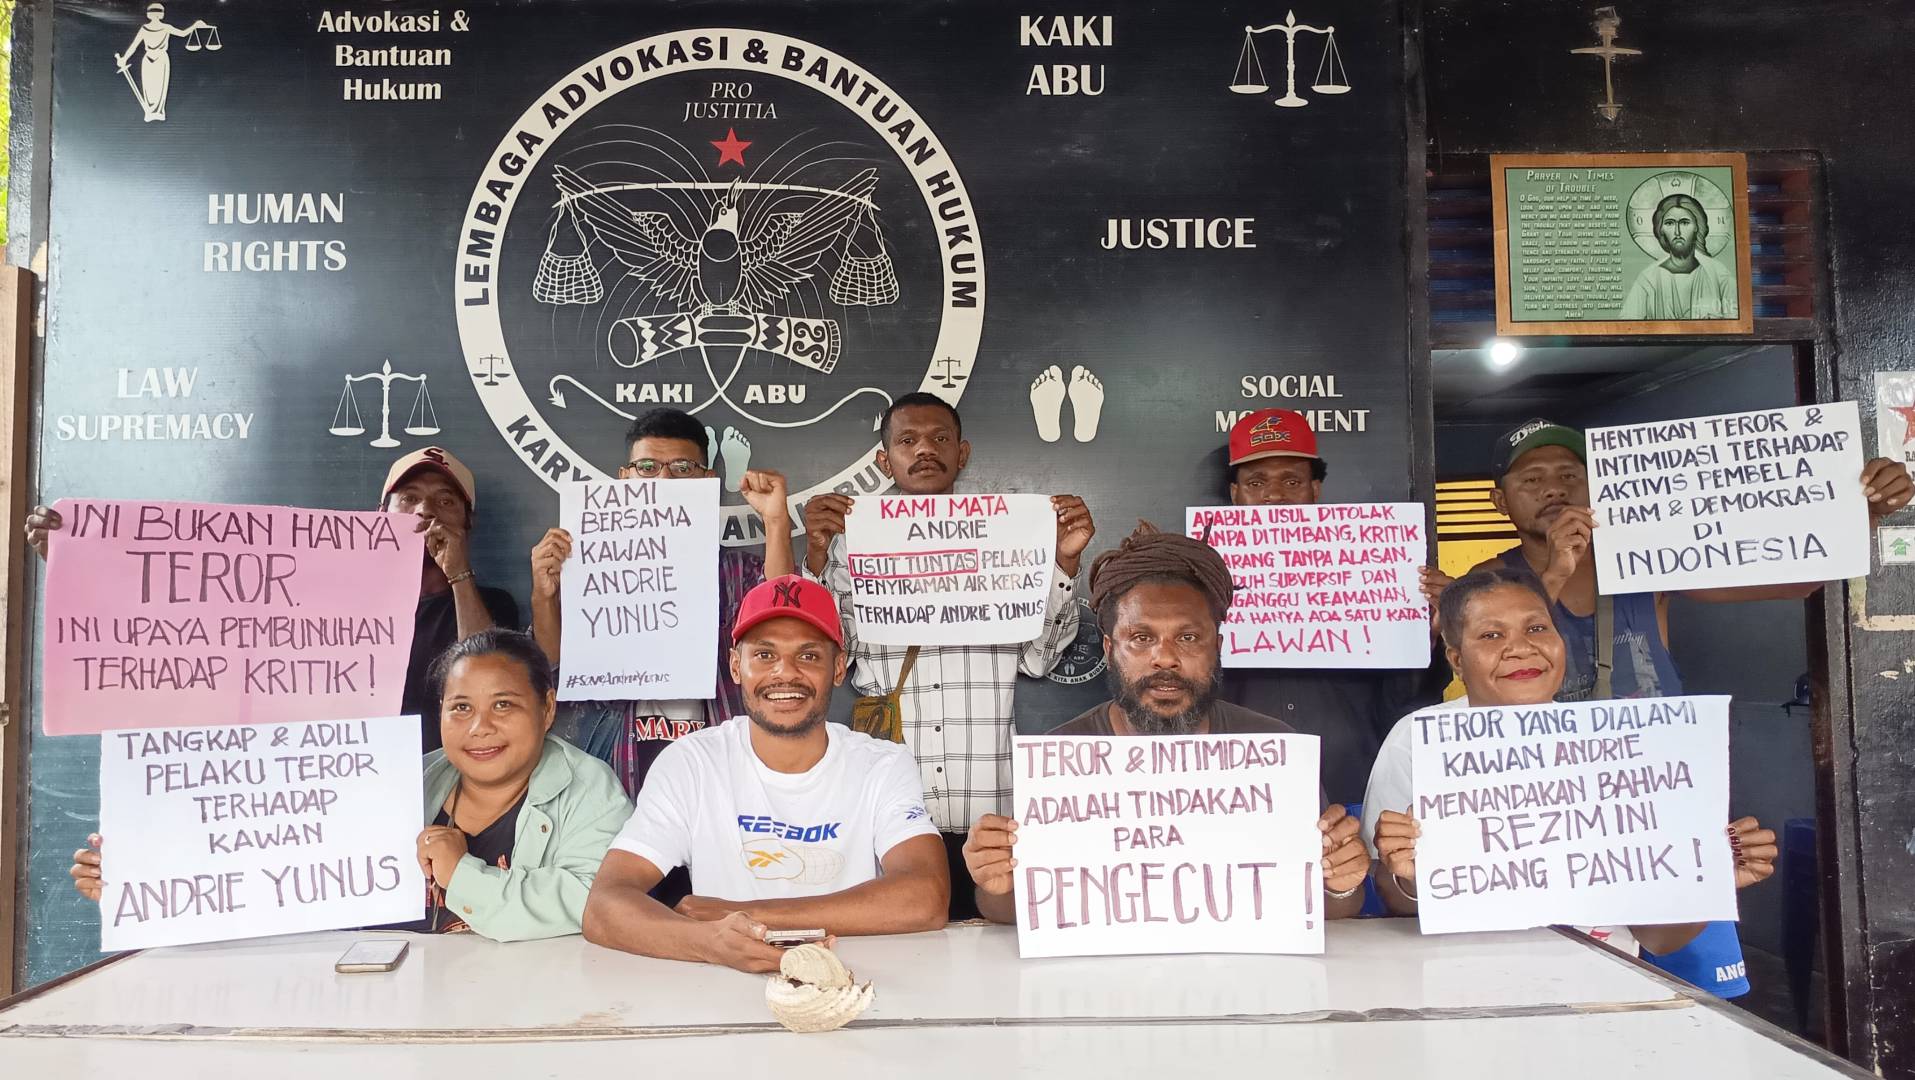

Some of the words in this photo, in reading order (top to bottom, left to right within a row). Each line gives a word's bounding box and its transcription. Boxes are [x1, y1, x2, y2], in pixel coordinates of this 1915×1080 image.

[318, 10, 439, 32] Advokasi
[451, 10, 469, 31] &
[1021, 16, 1112, 46] KAKI
[336, 45, 450, 66] Bantuan
[344, 79, 441, 100] Hukum
[711, 83, 752, 98] PRO
[1027, 65, 1104, 95] ABU
[684, 103, 776, 121] JUSTITIA
[463, 131, 543, 306] LEMBAGA
[541, 37, 728, 129] ADVOKASI
[742, 39, 769, 65] &
[780, 45, 936, 168] BANTUAN
[927, 170, 977, 308] HUKUM
[207, 193, 343, 224] HUMAN
[1101, 218, 1256, 249] JUSTICE
[202, 240, 346, 271] RIGHTS
[117, 367, 197, 398] LAW
[616, 384, 692, 402] KAKI
[744, 385, 805, 403] ABU
[1242, 376, 1343, 397] SOCIAL
[56, 413, 253, 439] SUPREMACY
[1215, 409, 1371, 433] MMENT
[1591, 422, 1696, 451] HENTIKAN
[1705, 413, 1788, 437] TEROR
[1805, 408, 1823, 426] &
[1596, 445, 1719, 477] INTIMIDASI
[1727, 431, 1848, 461] TERHADAP
[1598, 473, 1687, 502] AKTIVIS
[1697, 458, 1813, 490] PEMBELA
[585, 482, 656, 509] KAMI
[881, 498, 935, 519] KAMI
[949, 496, 1008, 517] MATA
[1609, 503, 1661, 525] HAM
[1669, 500, 1683, 516] &
[1691, 481, 1835, 516] DEMOKRASI
[71, 504, 120, 538] INI
[134, 506, 272, 545] BUKAN
[292, 513, 400, 551] HANYA
[581, 505, 691, 535] BERSAMA
[1269, 508, 1310, 523] USUL
[1318, 506, 1394, 522] DITOLAK
[907, 520, 987, 540] ANDRIE
[1253, 524, 1356, 546] DITIMBANG,
[1360, 524, 1419, 541] KRITIK
[1694, 521, 1722, 540] DI
[581, 536, 666, 564] KAWAN
[852, 556, 898, 575] USUT
[905, 553, 977, 574] TUNTAS
[982, 549, 1046, 569] PELAKU
[1280, 550, 1333, 567] TANPA
[1339, 547, 1413, 566] ALASAN,
[1616, 533, 1827, 579] INDONESIA
[126, 551, 299, 607] TEROR.
[583, 566, 677, 596] ANDRIE
[854, 576, 958, 595] PENYIRAMAN
[964, 575, 987, 592] AIR
[991, 571, 1043, 590] KERAS
[1269, 570, 1352, 587] SUBVERSIF
[1362, 568, 1397, 585] DAN
[1306, 587, 1411, 606] KEAMANAN,
[581, 601, 678, 638] YUNUS
[854, 604, 935, 624] TERHADAP
[940, 604, 990, 623] ANDRIE
[994, 600, 1044, 620] YUNUS
[1250, 612, 1304, 625] HANYA
[1309, 610, 1342, 622] ADA
[1345, 609, 1381, 622] SATU
[59, 617, 100, 643] INI
[114, 617, 209, 646] UPAYA
[221, 616, 394, 650] PEMBUNUHAN
[1231, 629, 1351, 654] LAWAN
[73, 656, 227, 690] TERHADAP
[1414, 710, 1504, 744] TEROR
[1514, 709, 1577, 736] YANG
[1591, 701, 1696, 732] DIALAMI
[117, 727, 257, 759] TANGKAP
[270, 727, 288, 747] &
[300, 721, 368, 748] ADILI
[1017, 741, 1112, 778] TEROR
[1125, 746, 1145, 773] &
[1152, 739, 1286, 774] INTIMIDASI
[1442, 743, 1545, 777] KAWAN
[1554, 734, 1643, 766] ANDRIE
[146, 758, 265, 795] PELAKU
[274, 753, 378, 783] TEROR
[1024, 792, 1120, 826] ADALAH
[1127, 783, 1272, 818] TINDAKAN
[1420, 776, 1586, 820] MENANDAKAN
[1598, 761, 1693, 800] BAHWA
[193, 789, 337, 823] TERHADAP
[209, 822, 322, 854] KAWAN
[1114, 825, 1184, 851] PARA
[1478, 805, 1607, 853] REZIM
[1615, 801, 1657, 834] INI
[1430, 857, 1548, 899] SEDANG
[1567, 844, 1679, 888] PANIK
[114, 872, 245, 927] ANDRIE
[262, 856, 400, 907] YUNUS
[1026, 863, 1277, 931] PENGECUT
